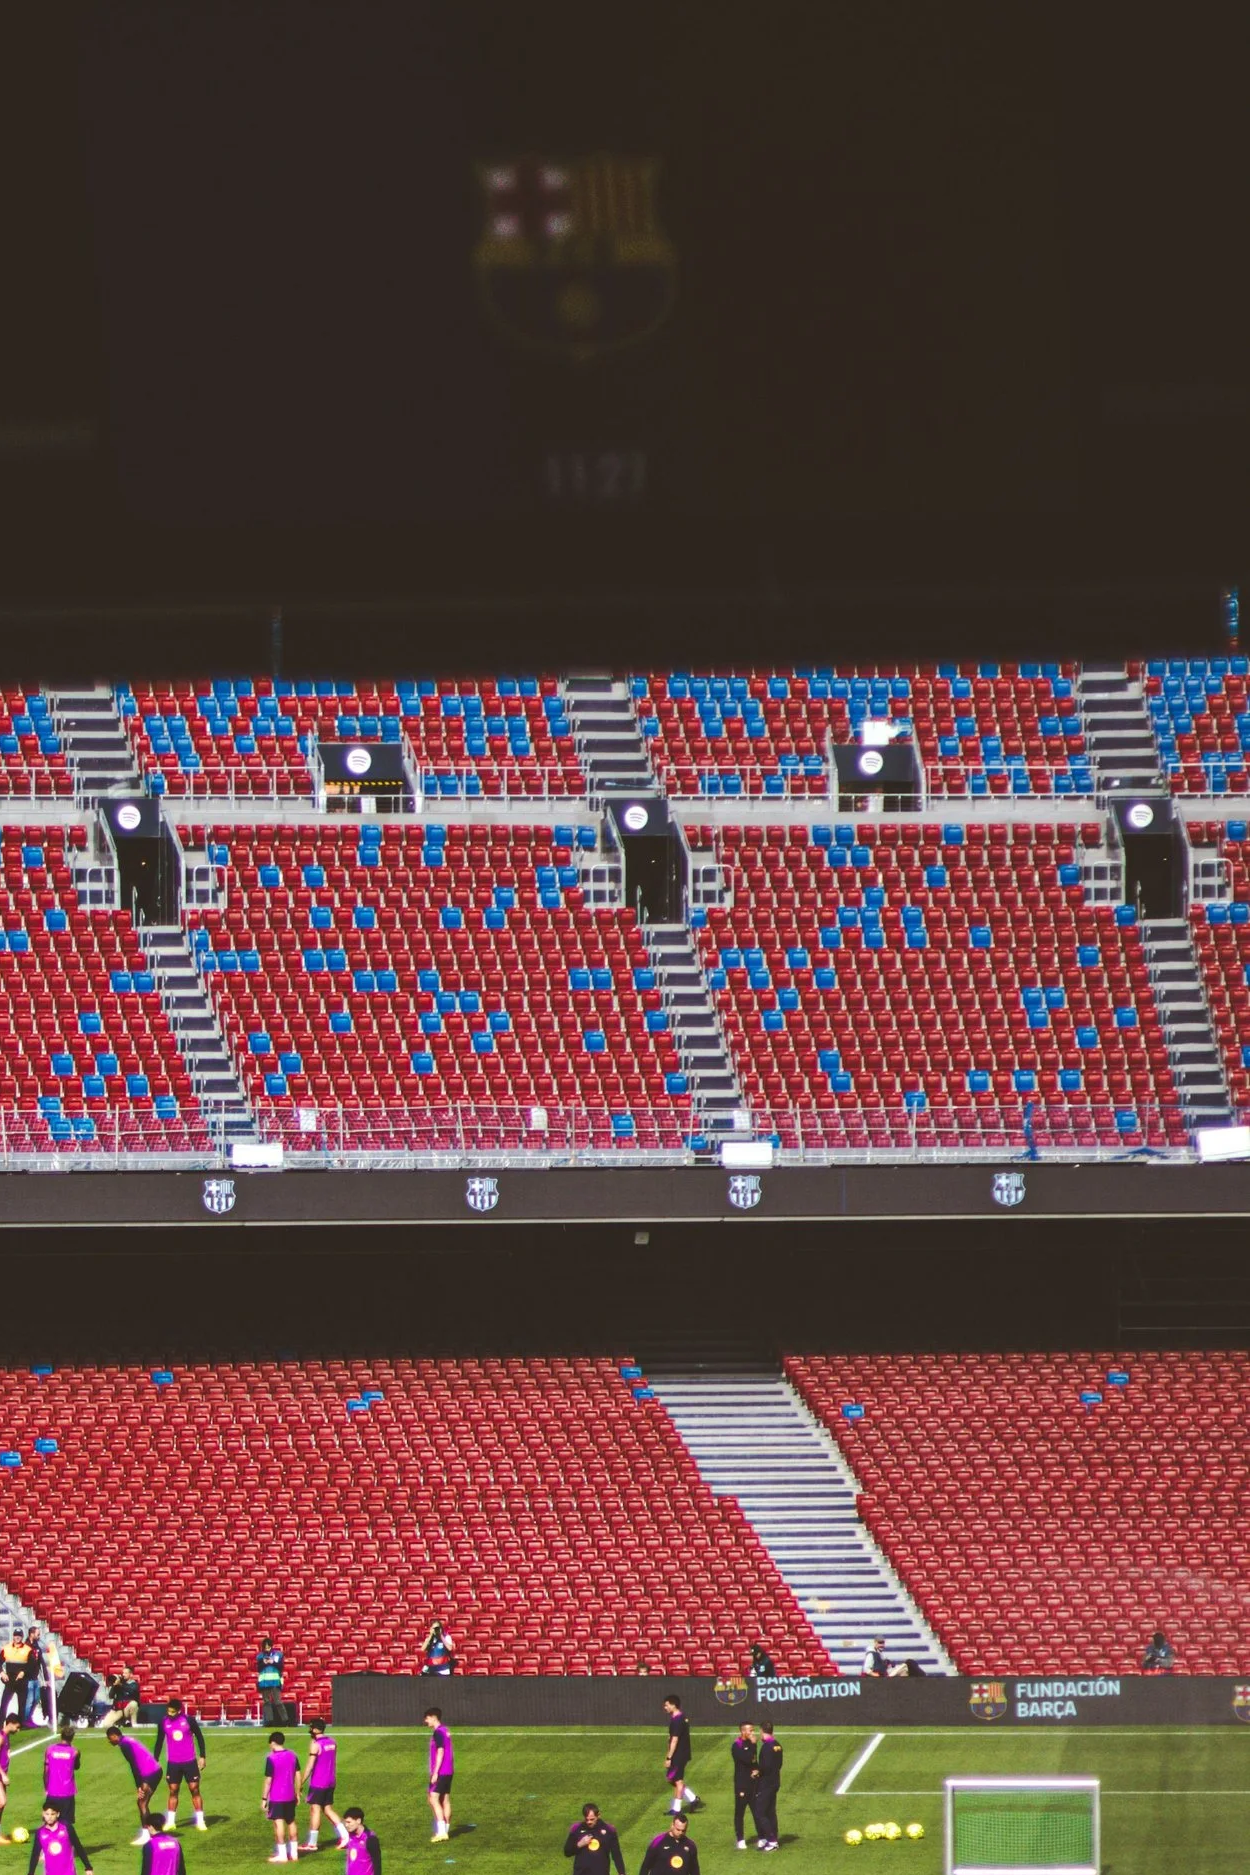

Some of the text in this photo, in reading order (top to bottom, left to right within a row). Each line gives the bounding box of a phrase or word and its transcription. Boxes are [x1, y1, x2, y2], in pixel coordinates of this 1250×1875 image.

[757, 1681, 861, 1703] FOUNDATION
[1016, 1676, 1121, 1698] FUNDACIÓN
[1017, 1700, 1078, 1719] BARÇA
